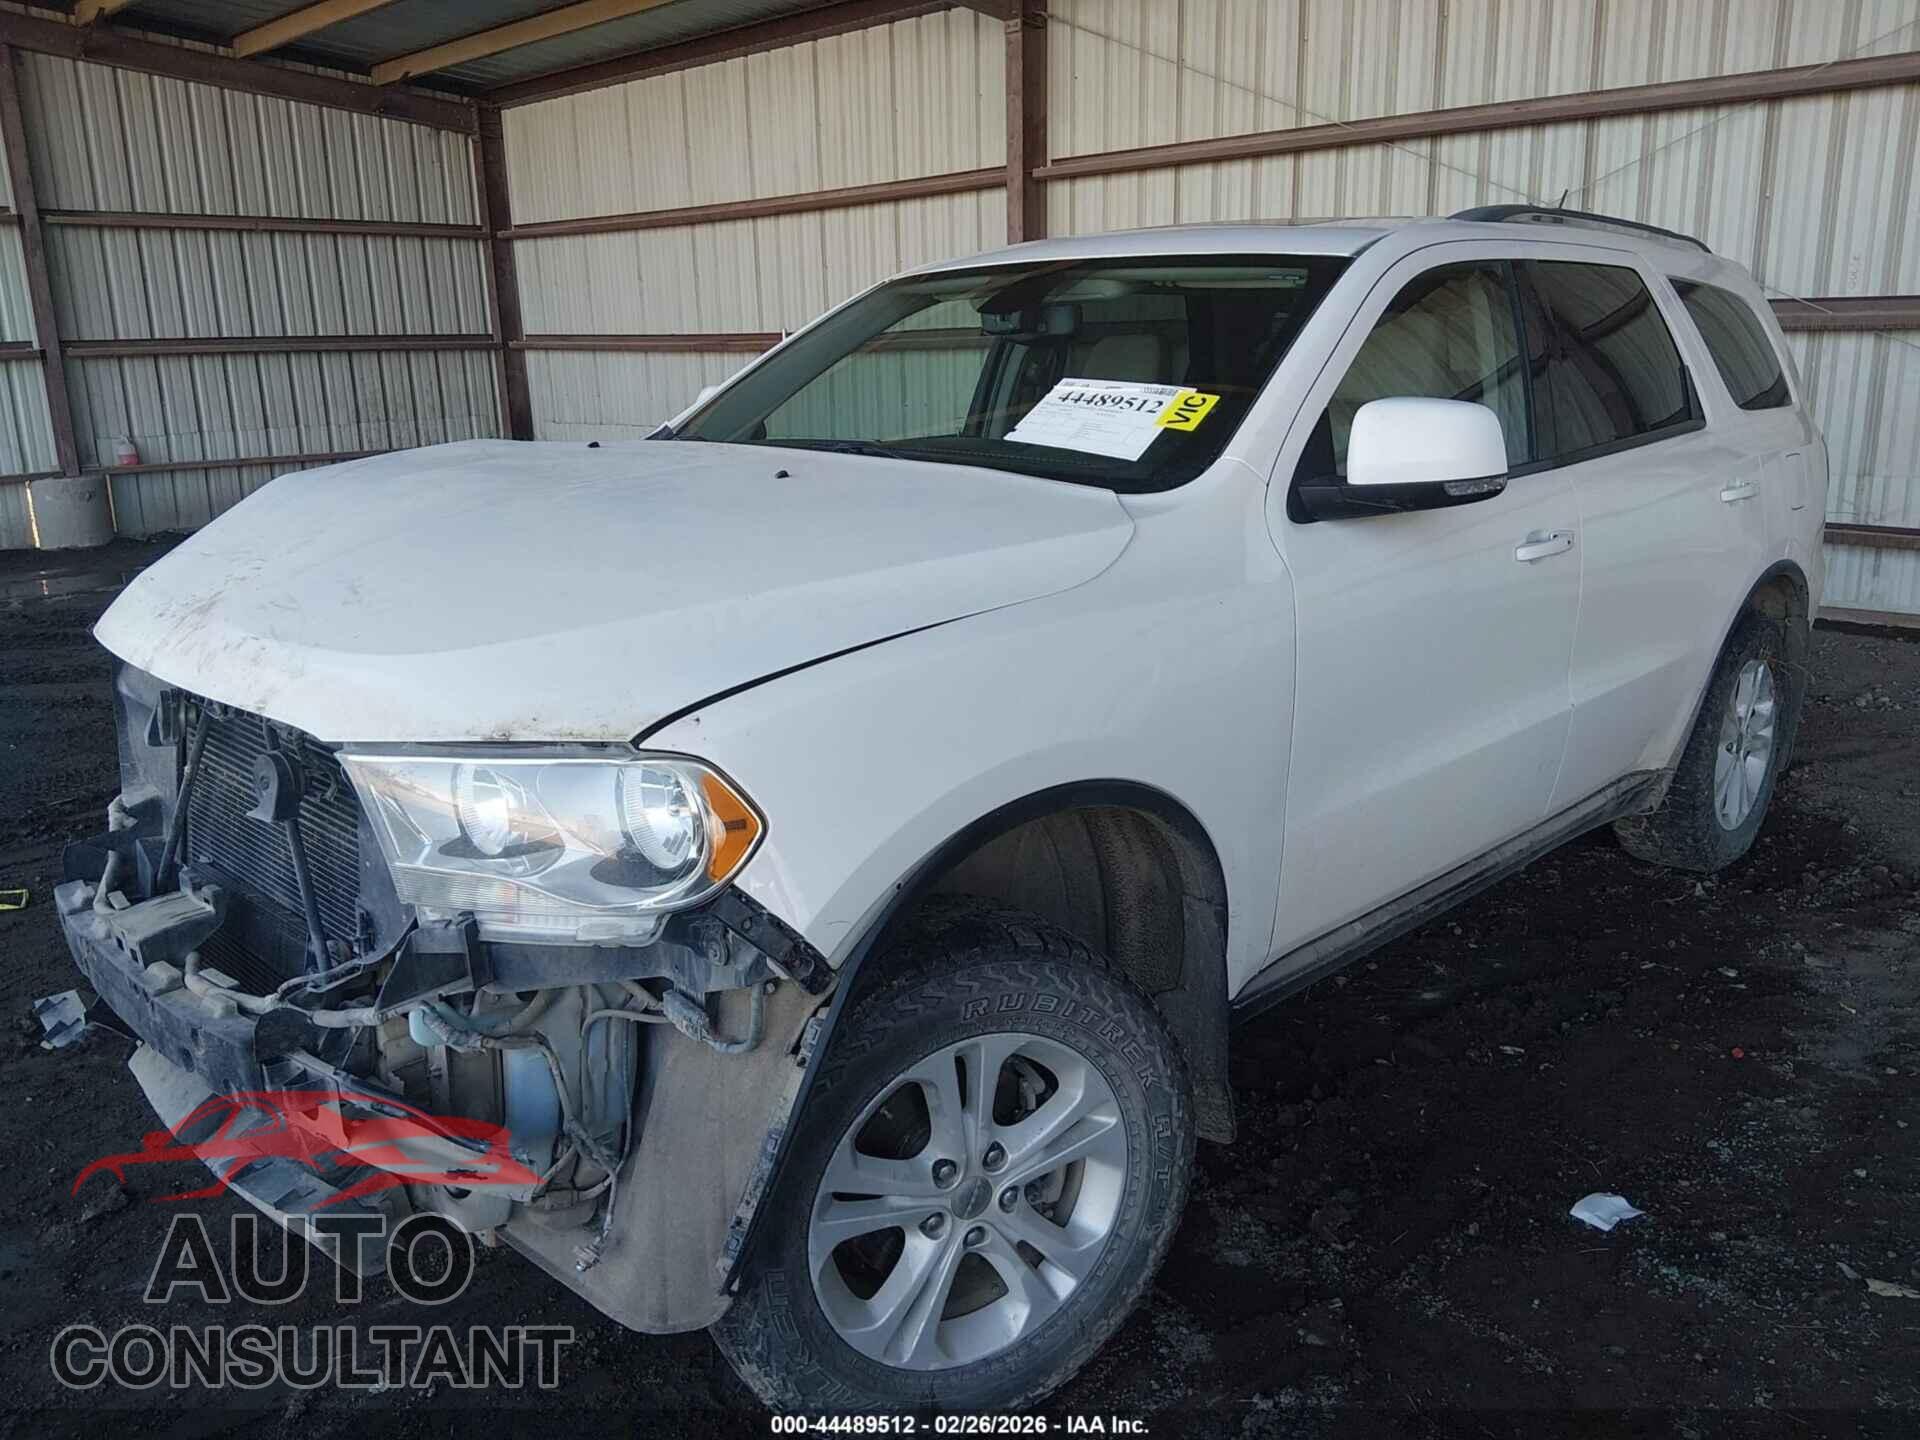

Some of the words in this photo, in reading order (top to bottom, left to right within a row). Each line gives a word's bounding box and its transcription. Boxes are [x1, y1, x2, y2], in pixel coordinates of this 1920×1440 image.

[1058, 390, 1164, 414] 44489512
[1166, 395, 1207, 426] VIC
[962, 991, 1161, 1089] RUBITREK
